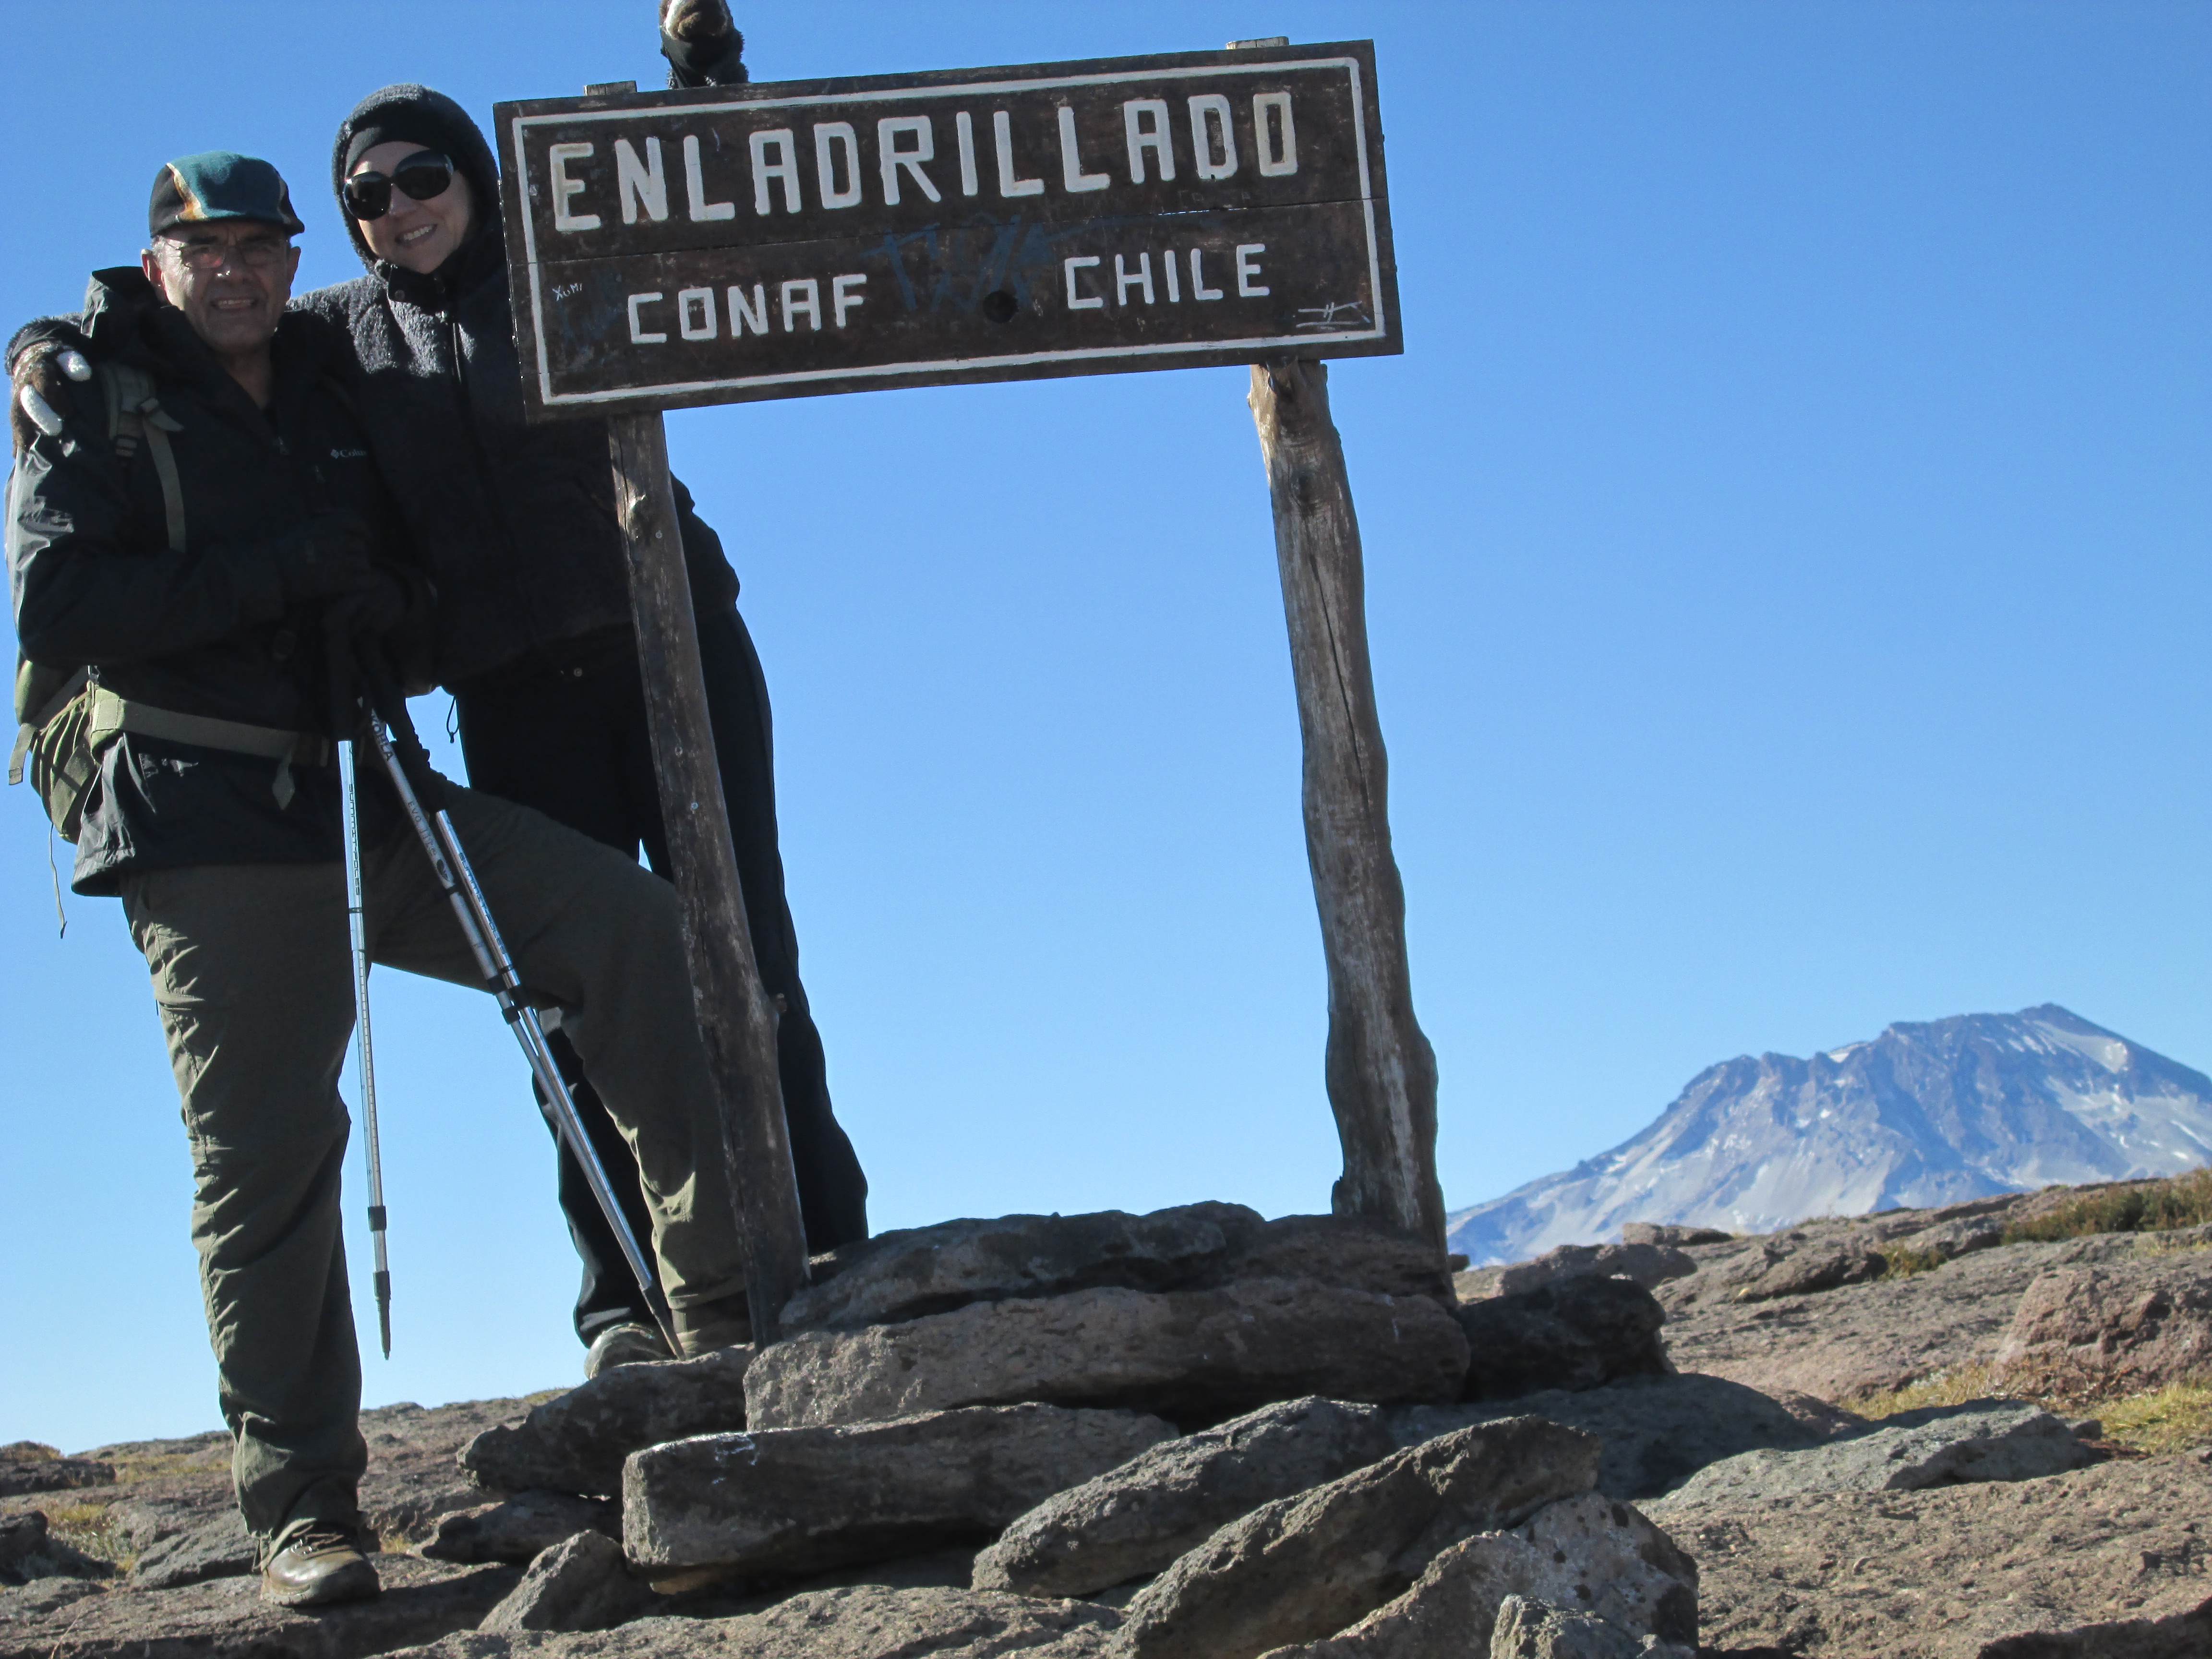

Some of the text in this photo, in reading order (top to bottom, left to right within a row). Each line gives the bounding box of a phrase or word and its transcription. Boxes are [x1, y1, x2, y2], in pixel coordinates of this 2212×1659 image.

[549, 92, 1298, 232] ENLADRILLADO
[627, 274, 867, 344] CONAF
[1064, 243, 1270, 310] CHILE
